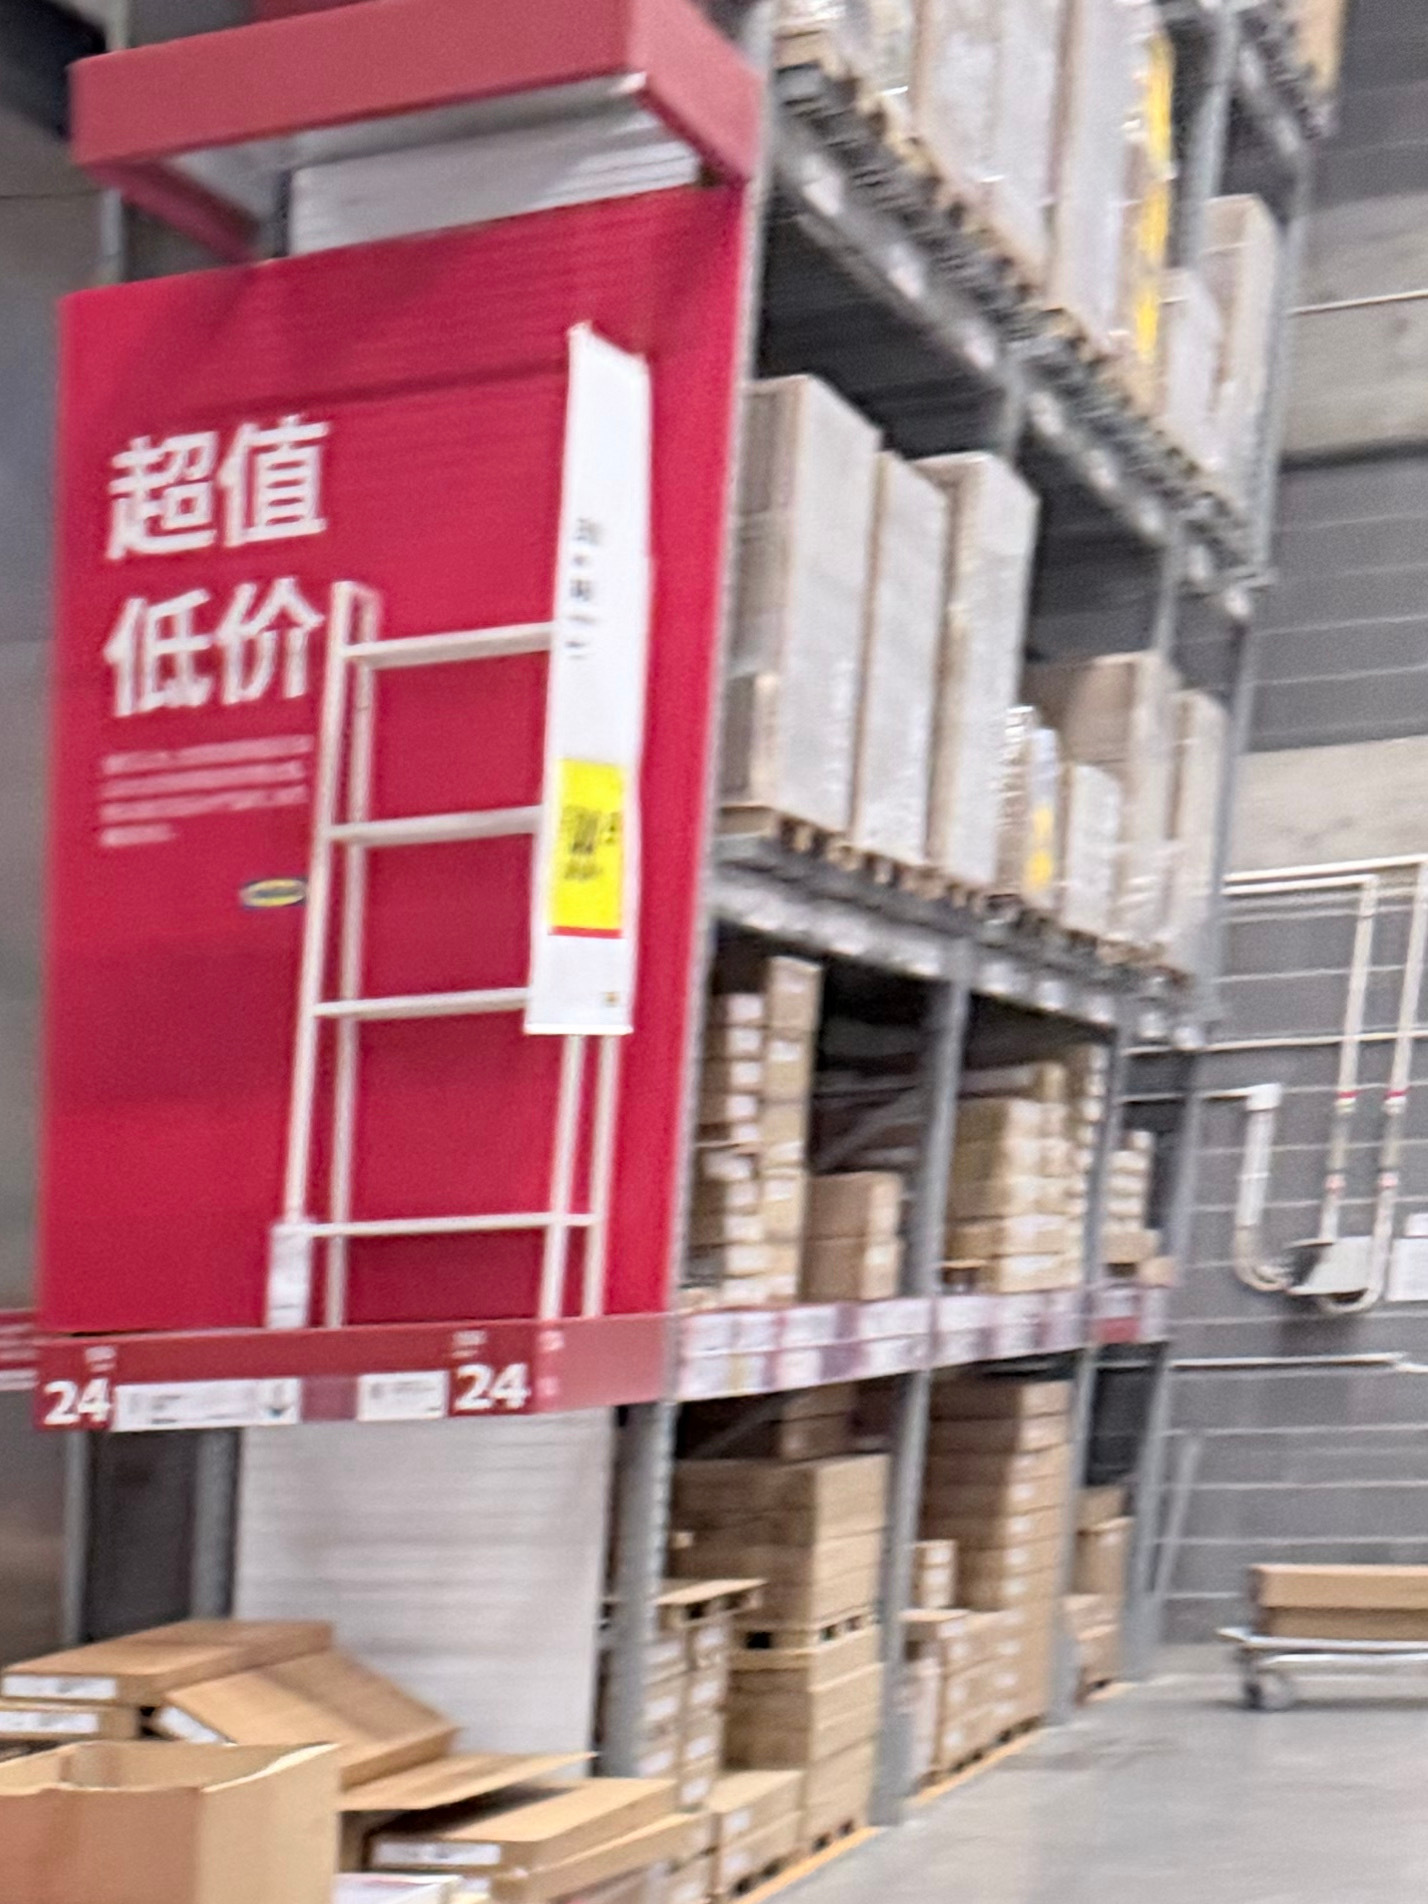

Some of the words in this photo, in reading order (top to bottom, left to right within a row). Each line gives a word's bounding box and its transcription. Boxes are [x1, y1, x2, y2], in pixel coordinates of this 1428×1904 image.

[106, 413, 332, 562] 超值
[103, 576, 326, 719] 低价
[43, 1376, 112, 1426] 24
[453, 1362, 533, 1412] 24
